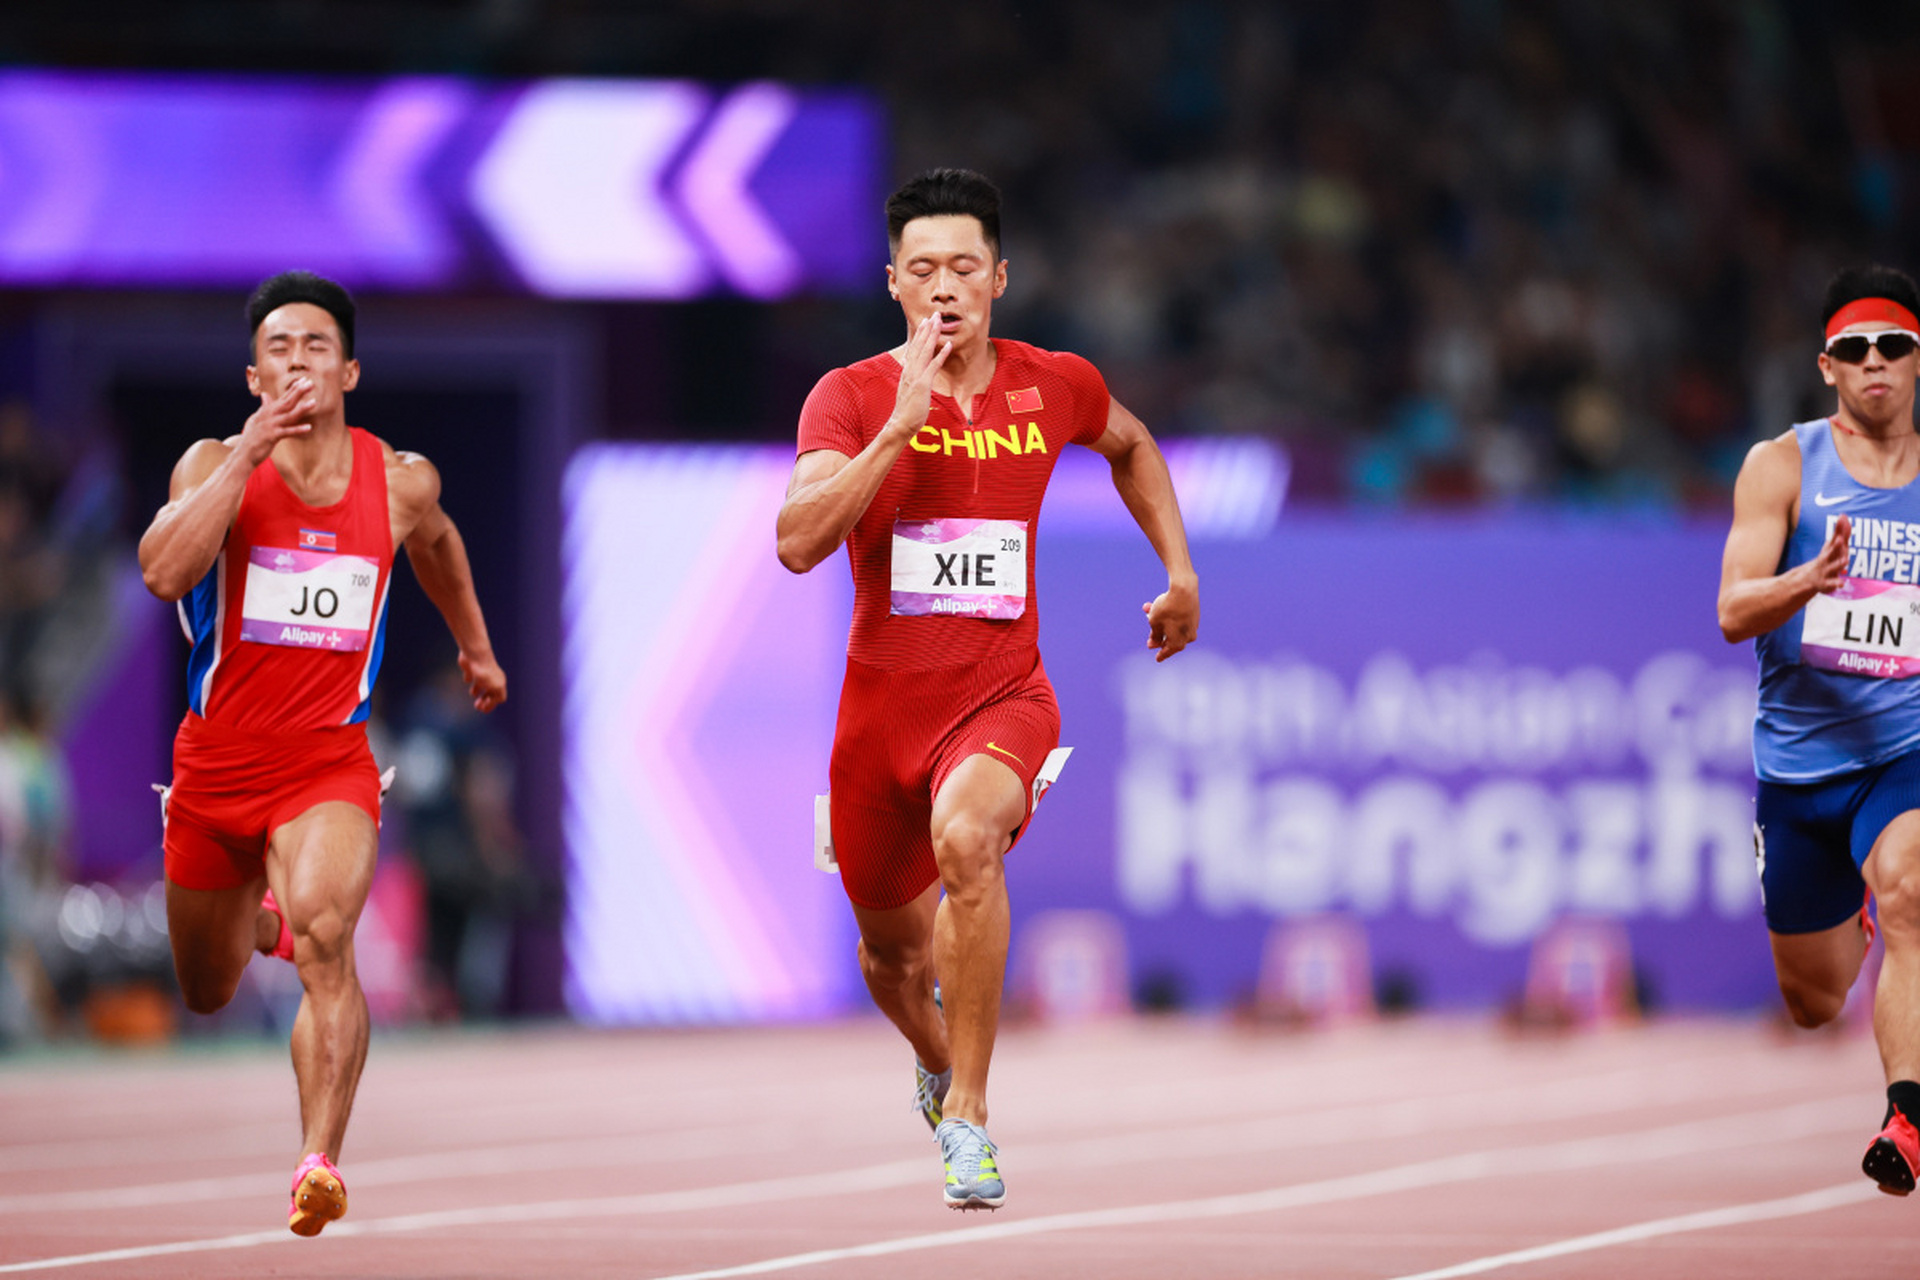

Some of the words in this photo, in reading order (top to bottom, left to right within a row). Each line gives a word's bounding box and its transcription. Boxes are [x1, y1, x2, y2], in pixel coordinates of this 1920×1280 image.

[909, 422, 1047, 459] CHINA
[351, 573, 371, 587] 700
[932, 553, 996, 586] XIE
[290, 586, 339, 618] JO
[1843, 610, 1904, 647] LIN
